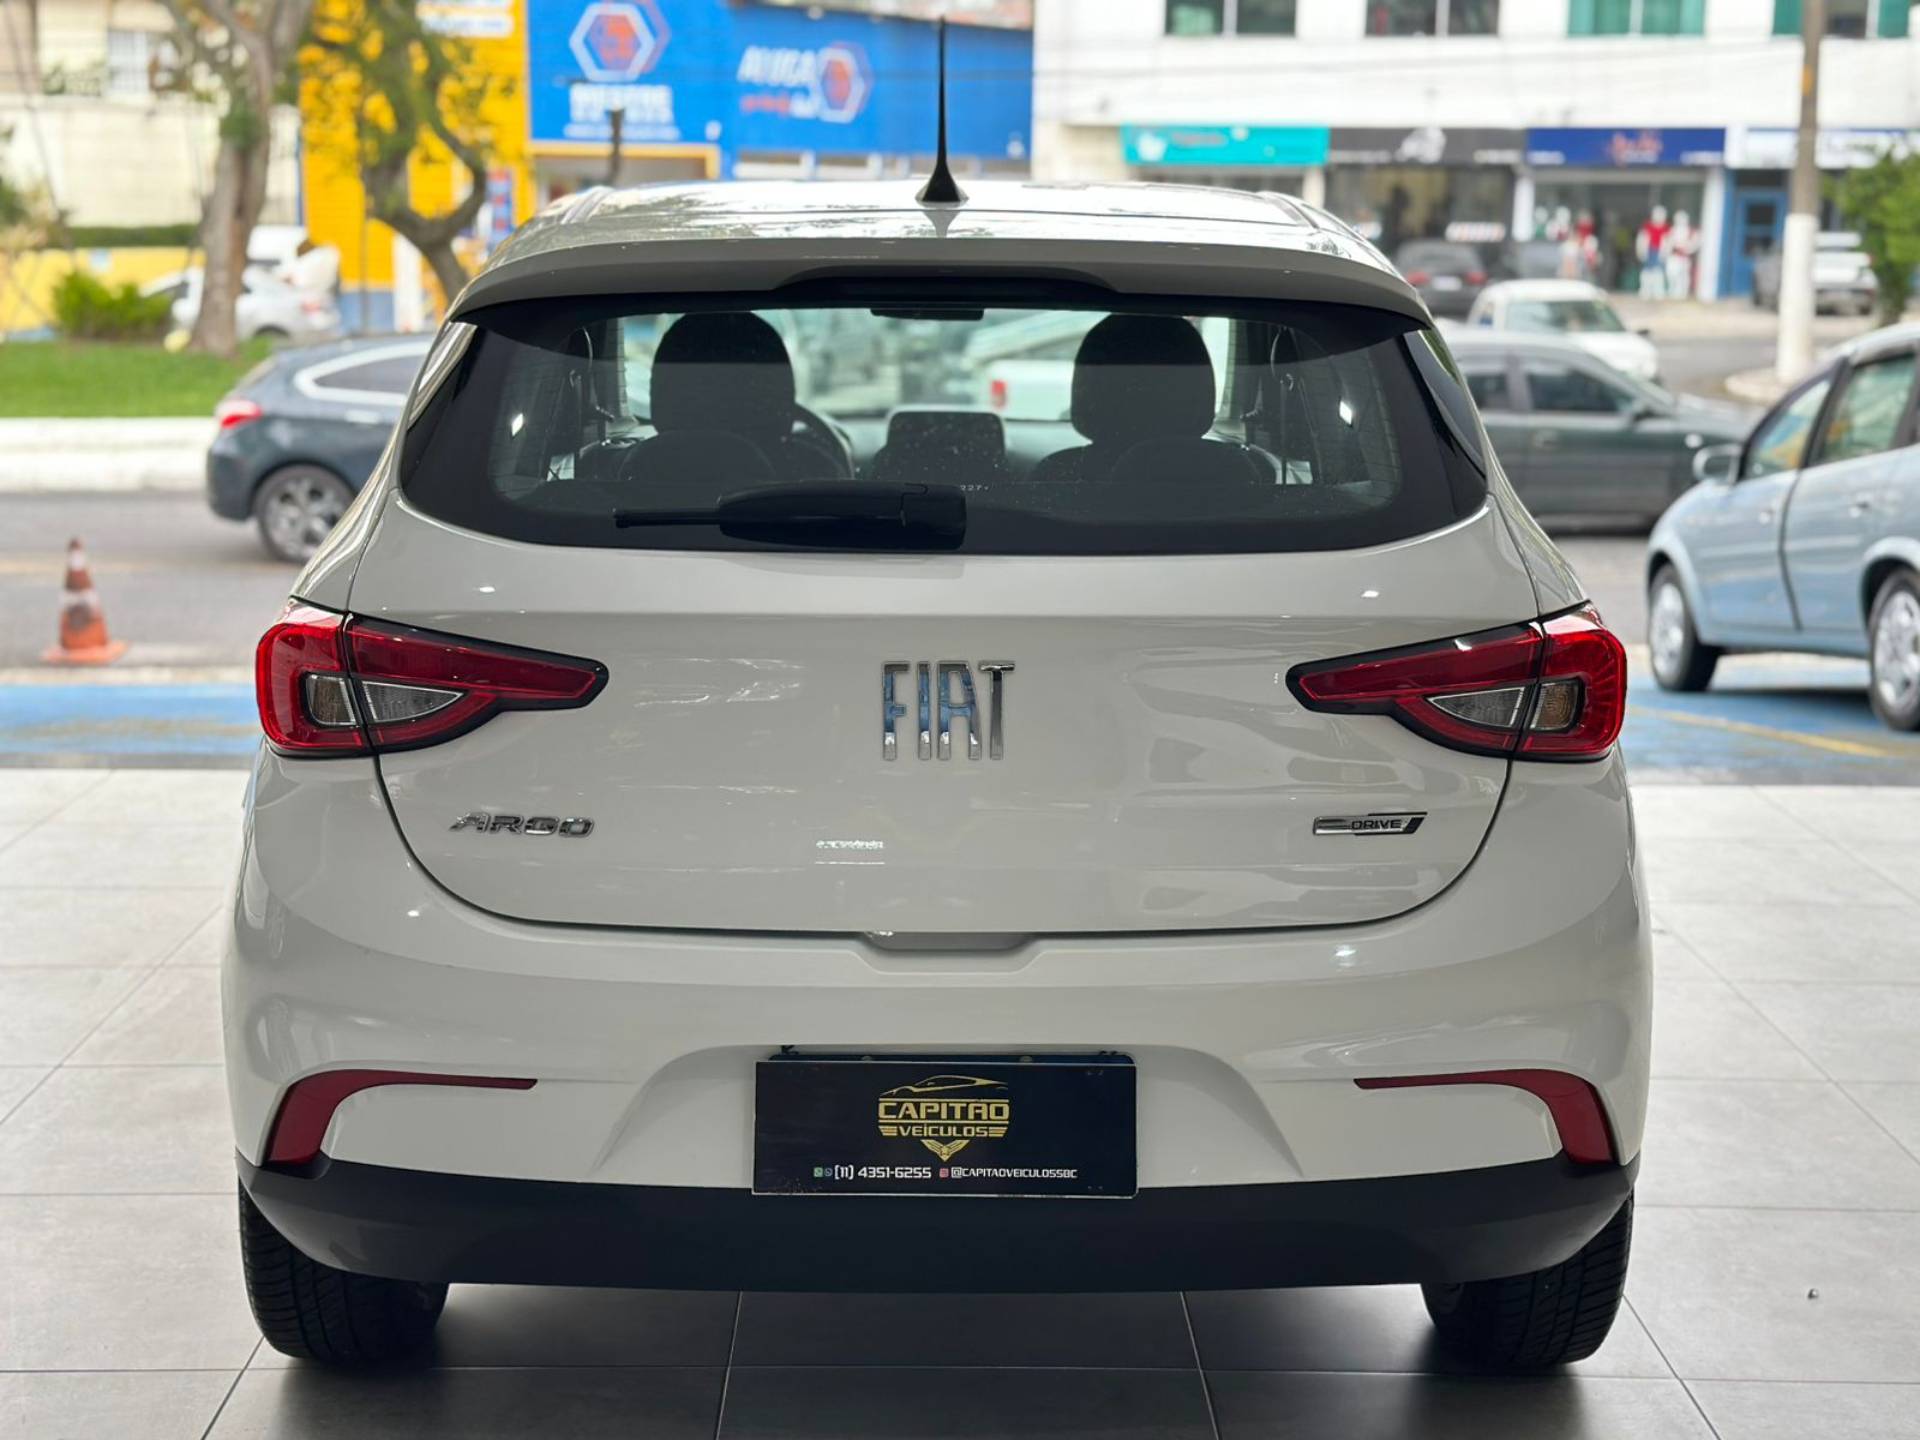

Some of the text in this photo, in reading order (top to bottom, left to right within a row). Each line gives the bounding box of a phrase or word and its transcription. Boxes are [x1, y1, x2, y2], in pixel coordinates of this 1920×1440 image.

[882, 660, 1016, 761] FIAT
[449, 812, 594, 837] ARGO
[858, 1166, 932, 1179] 4351-6255
